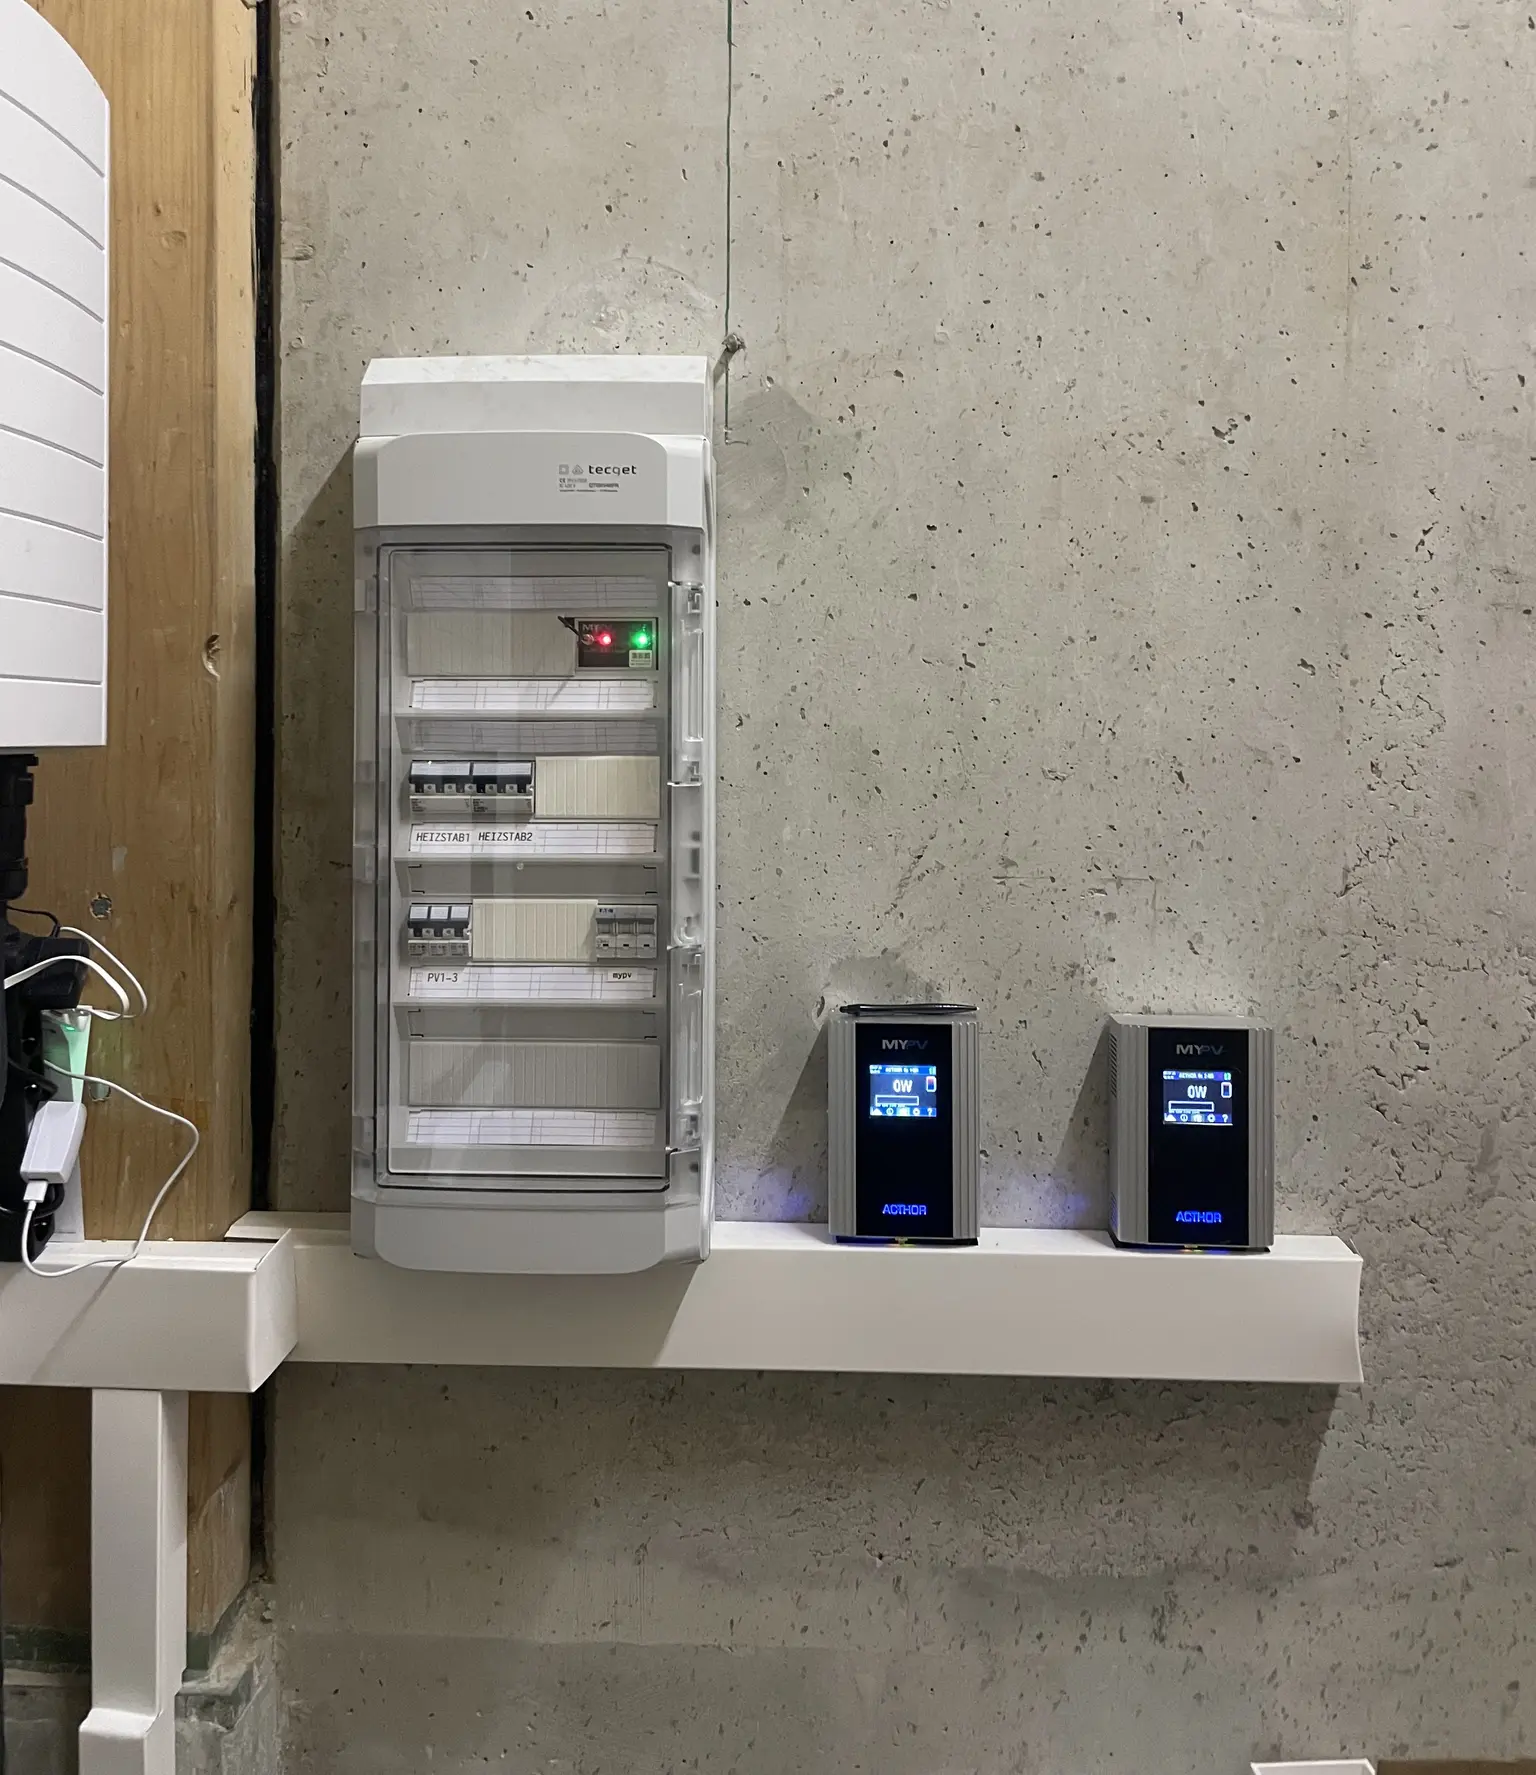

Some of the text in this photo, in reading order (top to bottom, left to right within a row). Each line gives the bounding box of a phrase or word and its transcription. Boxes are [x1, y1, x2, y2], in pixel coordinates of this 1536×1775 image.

[416, 831, 533, 842] HEIZSTAB1 HEIZSTAB2
[427, 972, 458, 982] PV1-3
[882, 1203, 927, 1216] ACTHOR
[1175, 1210, 1222, 1224] ACTHOR
